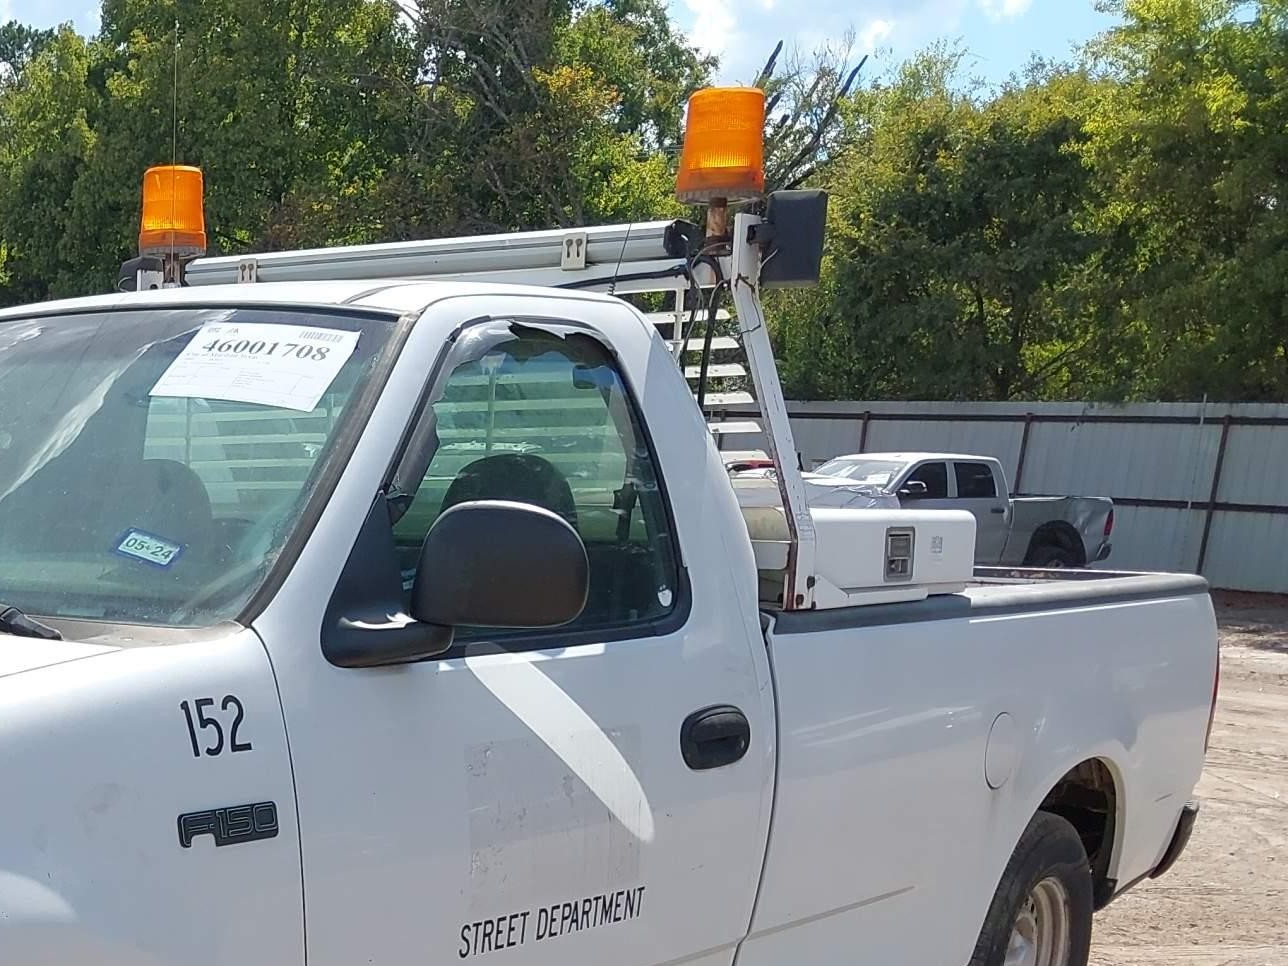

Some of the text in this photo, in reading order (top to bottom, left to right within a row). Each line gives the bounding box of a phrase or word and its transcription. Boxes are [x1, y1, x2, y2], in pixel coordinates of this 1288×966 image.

[201, 337, 331, 361] 46001708
[180, 694, 253, 757] 152
[458, 886, 646, 959] STREET DEPARTMENT
